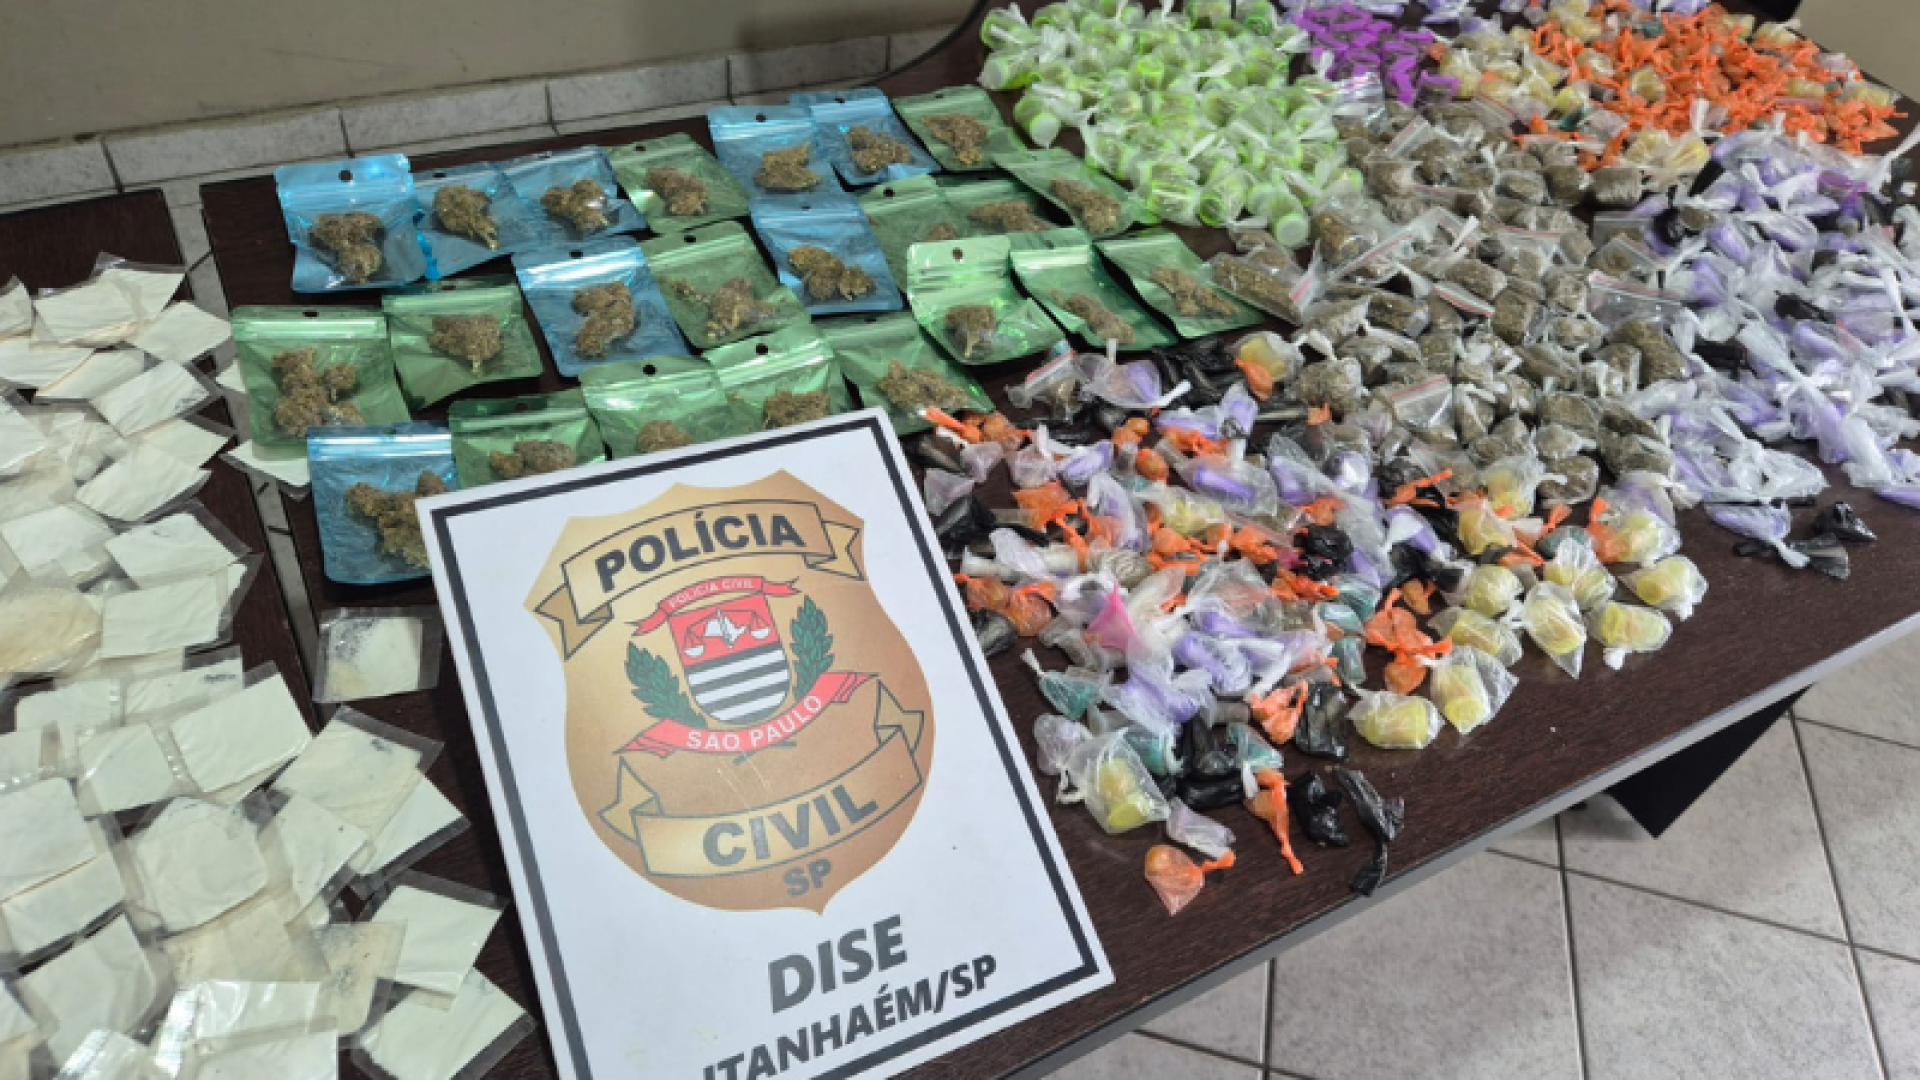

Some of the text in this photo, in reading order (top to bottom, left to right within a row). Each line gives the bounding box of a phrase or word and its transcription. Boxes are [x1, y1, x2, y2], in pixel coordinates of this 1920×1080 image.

[595, 511, 806, 593] POLÍCIA
[749, 695, 822, 748] PAULO
[702, 784, 877, 867] CIVIL
[783, 858, 832, 896] SP
[768, 914, 907, 1013] DISE
